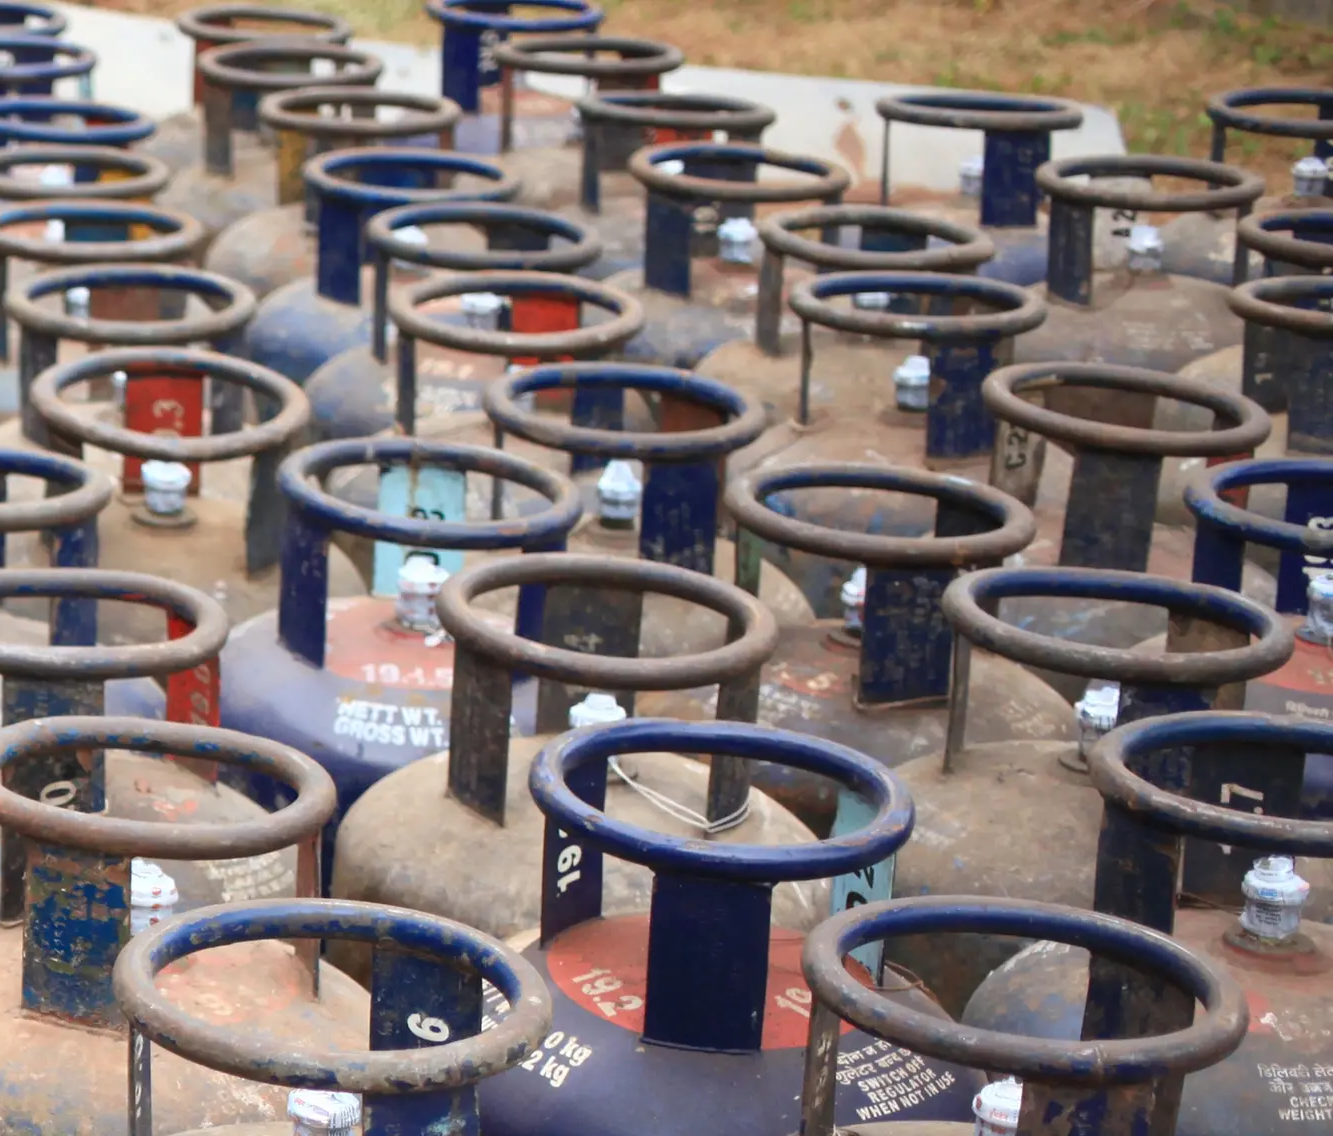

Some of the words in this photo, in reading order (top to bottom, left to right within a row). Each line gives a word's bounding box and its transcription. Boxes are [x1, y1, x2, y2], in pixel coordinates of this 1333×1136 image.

[336, 699, 399, 725] NETT
[400, 706, 444, 727] WT.
[333, 716, 407, 747] GROSS
[407, 726, 451, 748] WT.
[572, 967, 645, 1018] 19.2
[563, 1036, 593, 1067] kg
[540, 1054, 570, 1088] kg
[857, 1066, 909, 1092] SWITCH
[905, 1054, 927, 1074] OFF
[866, 1067, 937, 1104] REGULATOR
[855, 1099, 901, 1121] WHEN
[901, 1089, 926, 1109] NOT
[924, 1082, 940, 1098] IN
[936, 1070, 957, 1091] USE
